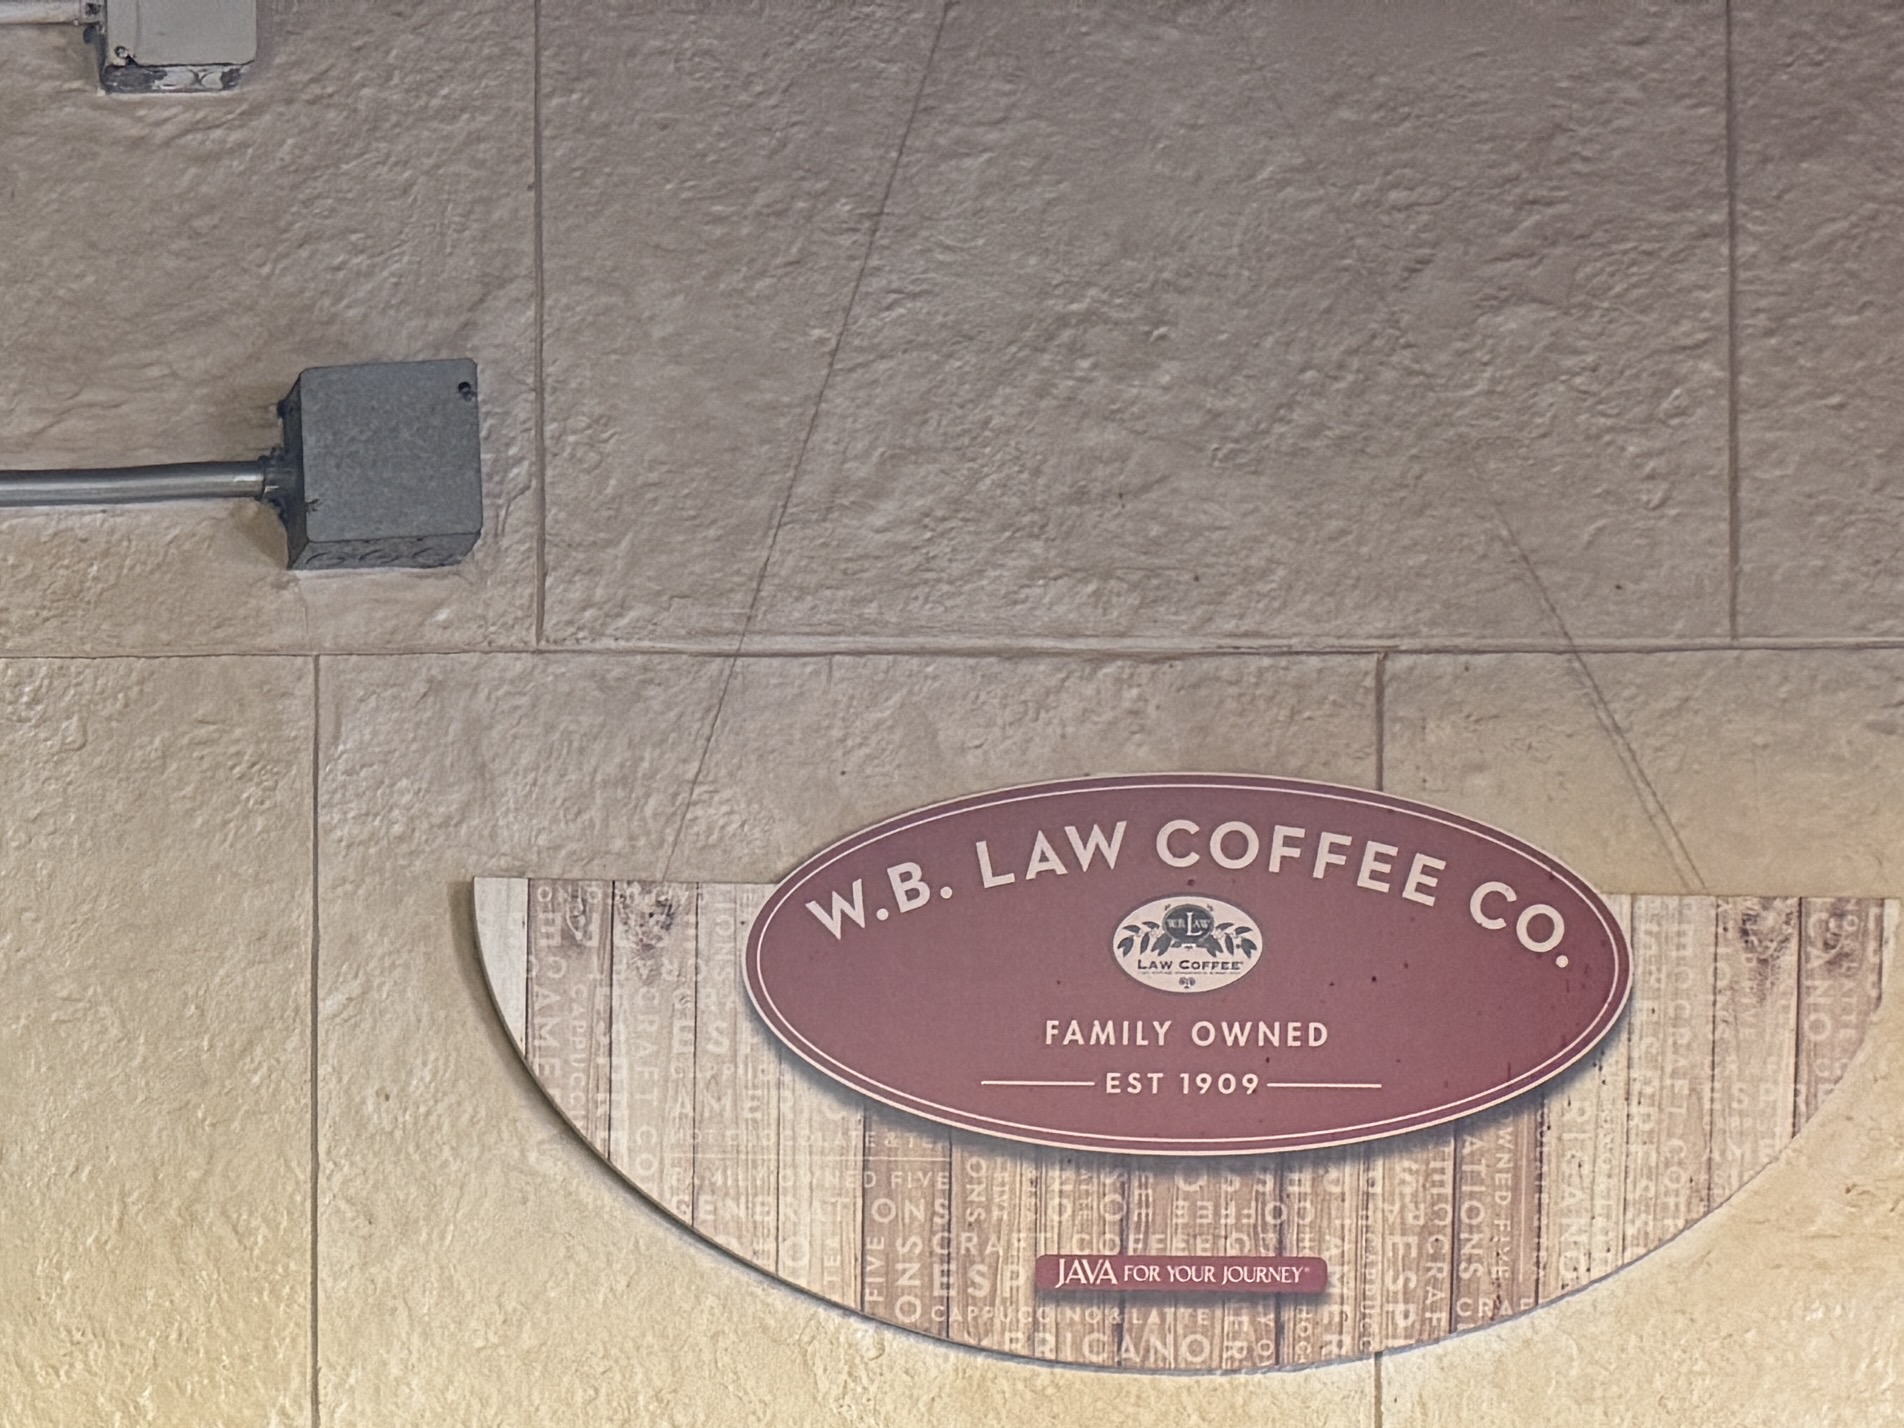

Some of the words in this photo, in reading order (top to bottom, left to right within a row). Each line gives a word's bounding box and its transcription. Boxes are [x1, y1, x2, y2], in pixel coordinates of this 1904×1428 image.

[807, 863, 954, 941] W.B.
[977, 820, 1128, 889] LAW
[1156, 820, 1447, 907] COFFEE
[1470, 882, 1571, 969] CO.
[1138, 959, 1173, 969] LAW
[1179, 960, 1240, 970] COFFEE
[1045, 1020, 1172, 1049] FAMILY
[1192, 1021, 1329, 1049] OWNED
[1105, 1073, 1170, 1095] EST
[1181, 1071, 1259, 1096] 1909
[1056, 1259, 1119, 1289] JAVA
[1124, 1267, 1161, 1286] FOR
[1167, 1267, 1217, 1286] YOUR
